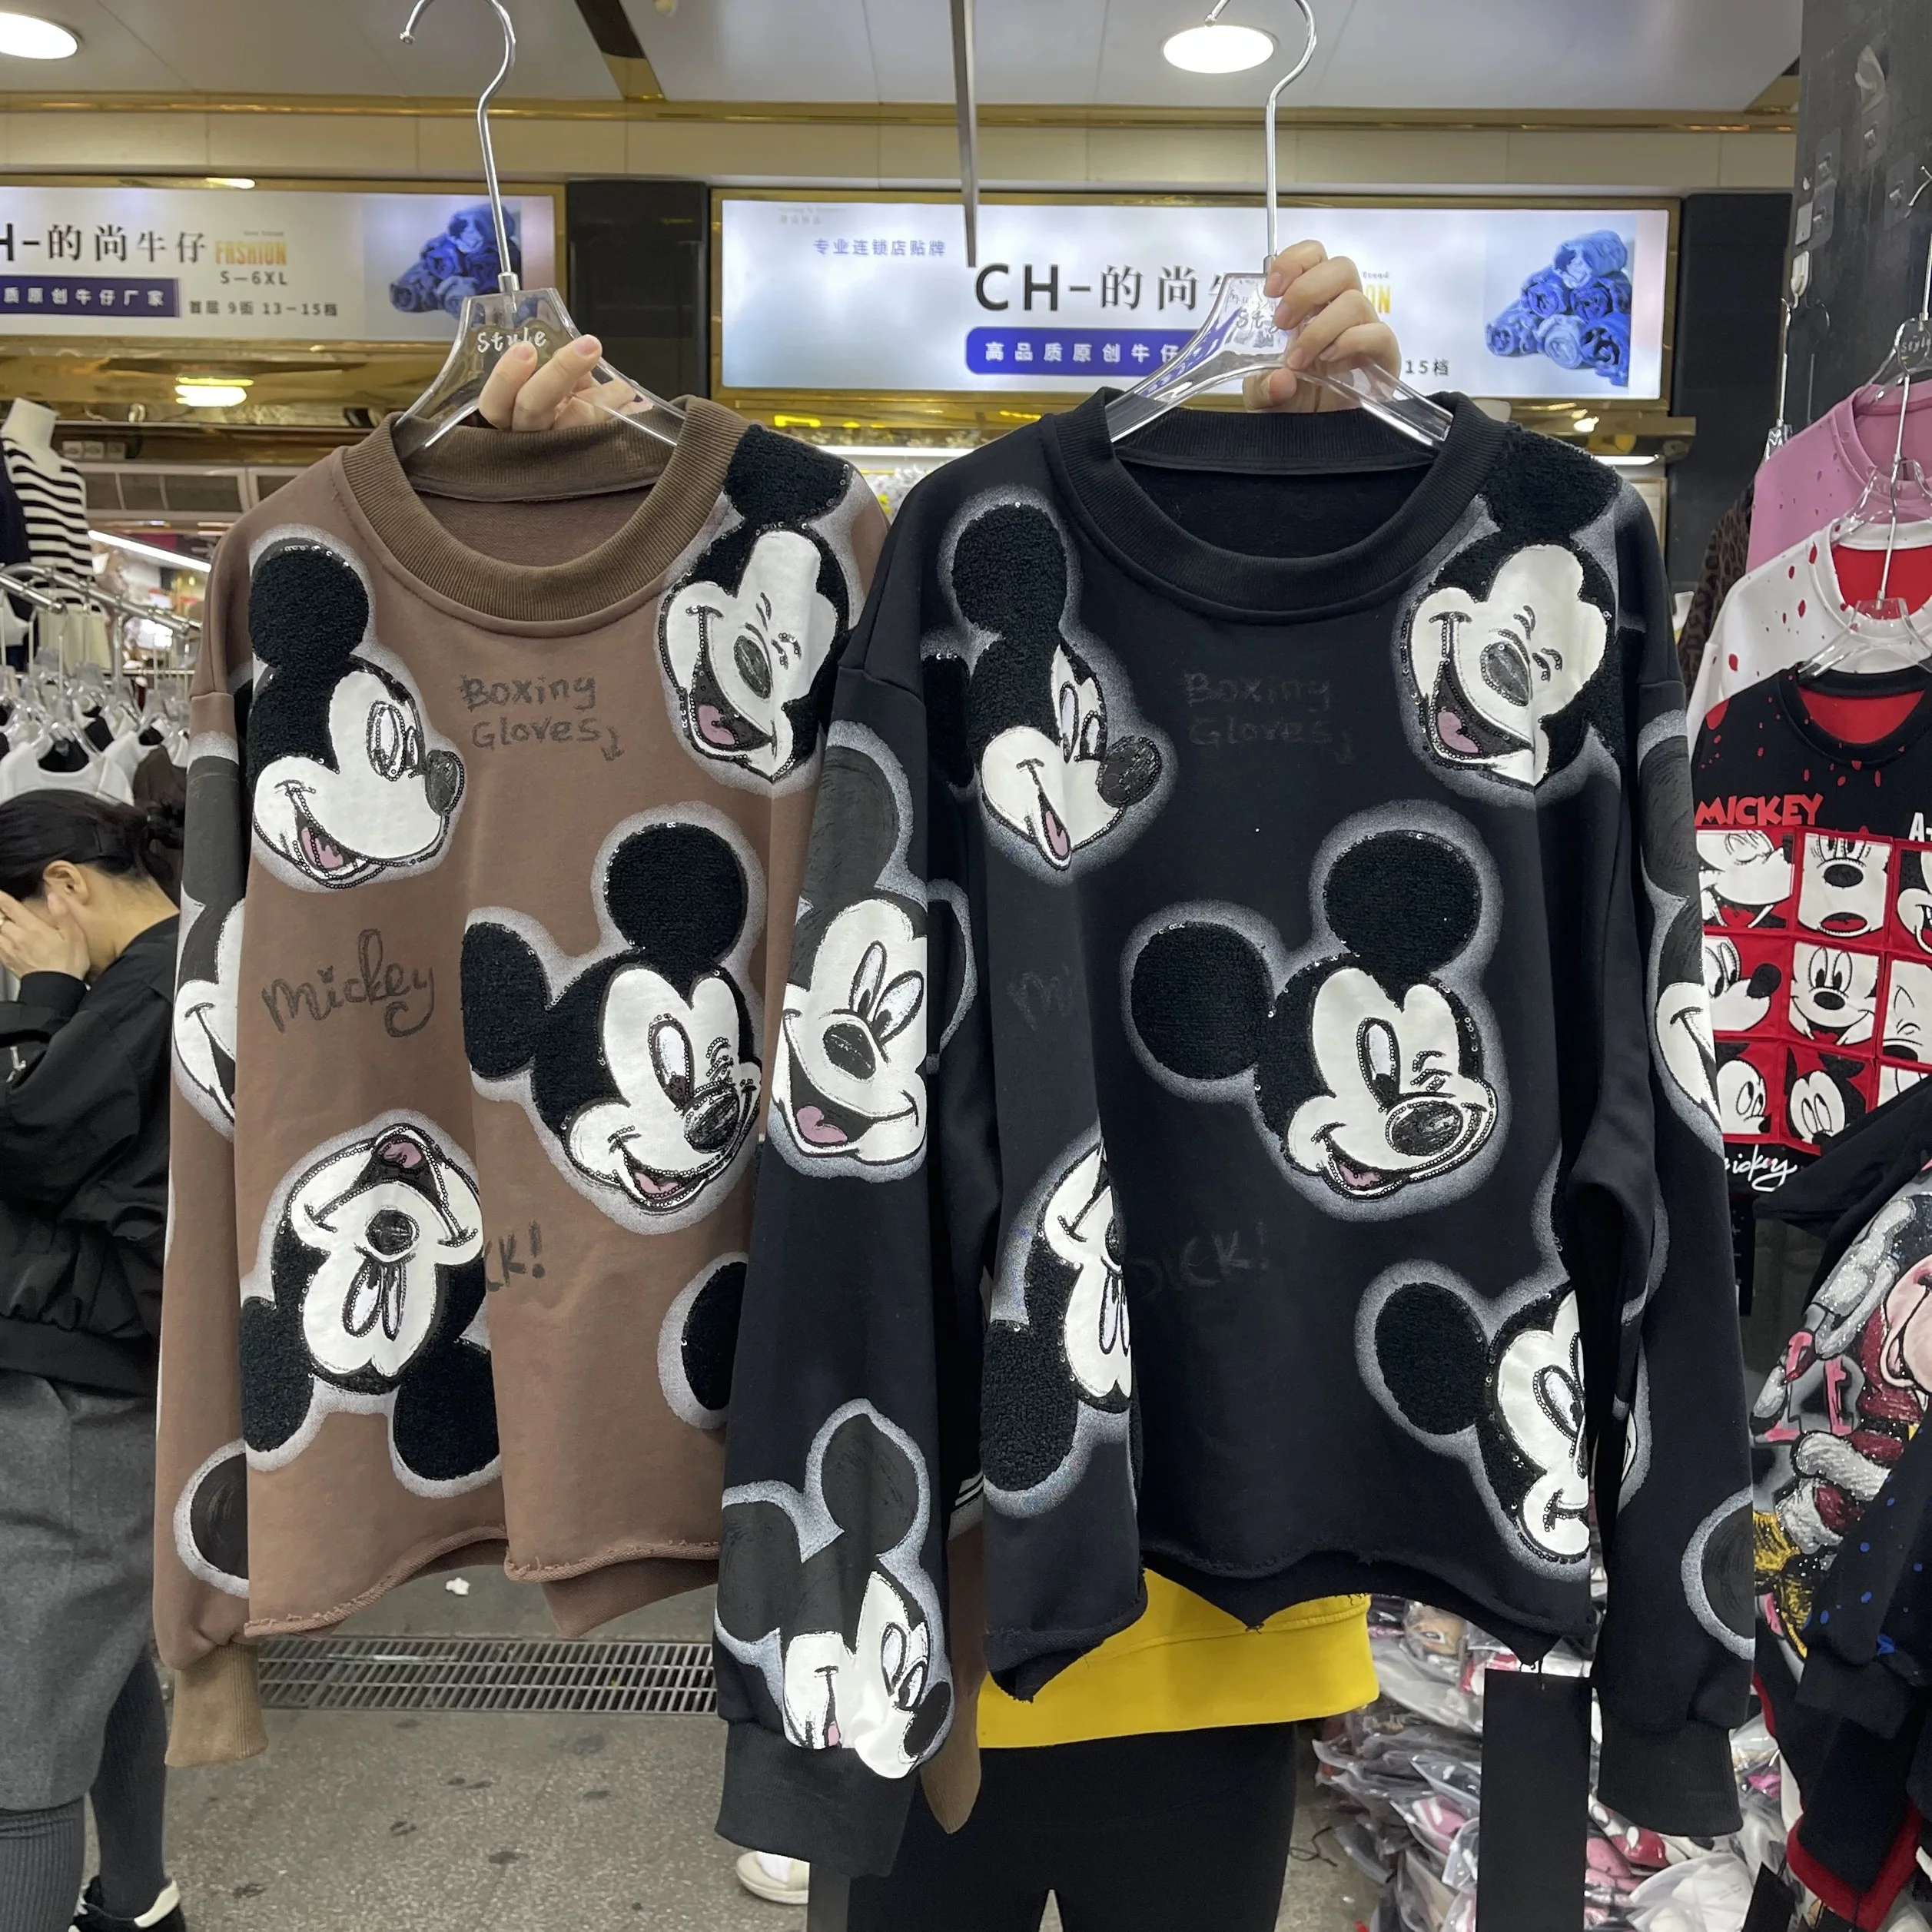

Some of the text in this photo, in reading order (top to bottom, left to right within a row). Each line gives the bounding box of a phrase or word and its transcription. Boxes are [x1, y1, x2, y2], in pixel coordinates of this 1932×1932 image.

[813, 237, 946, 257] 专业连锁店贴牌
[460, 675, 596, 712] Boxing
[1183, 670, 1330, 712] Boxing
[472, 716, 601, 750] Gloves
[1695, 793, 1824, 827] MICKEY
